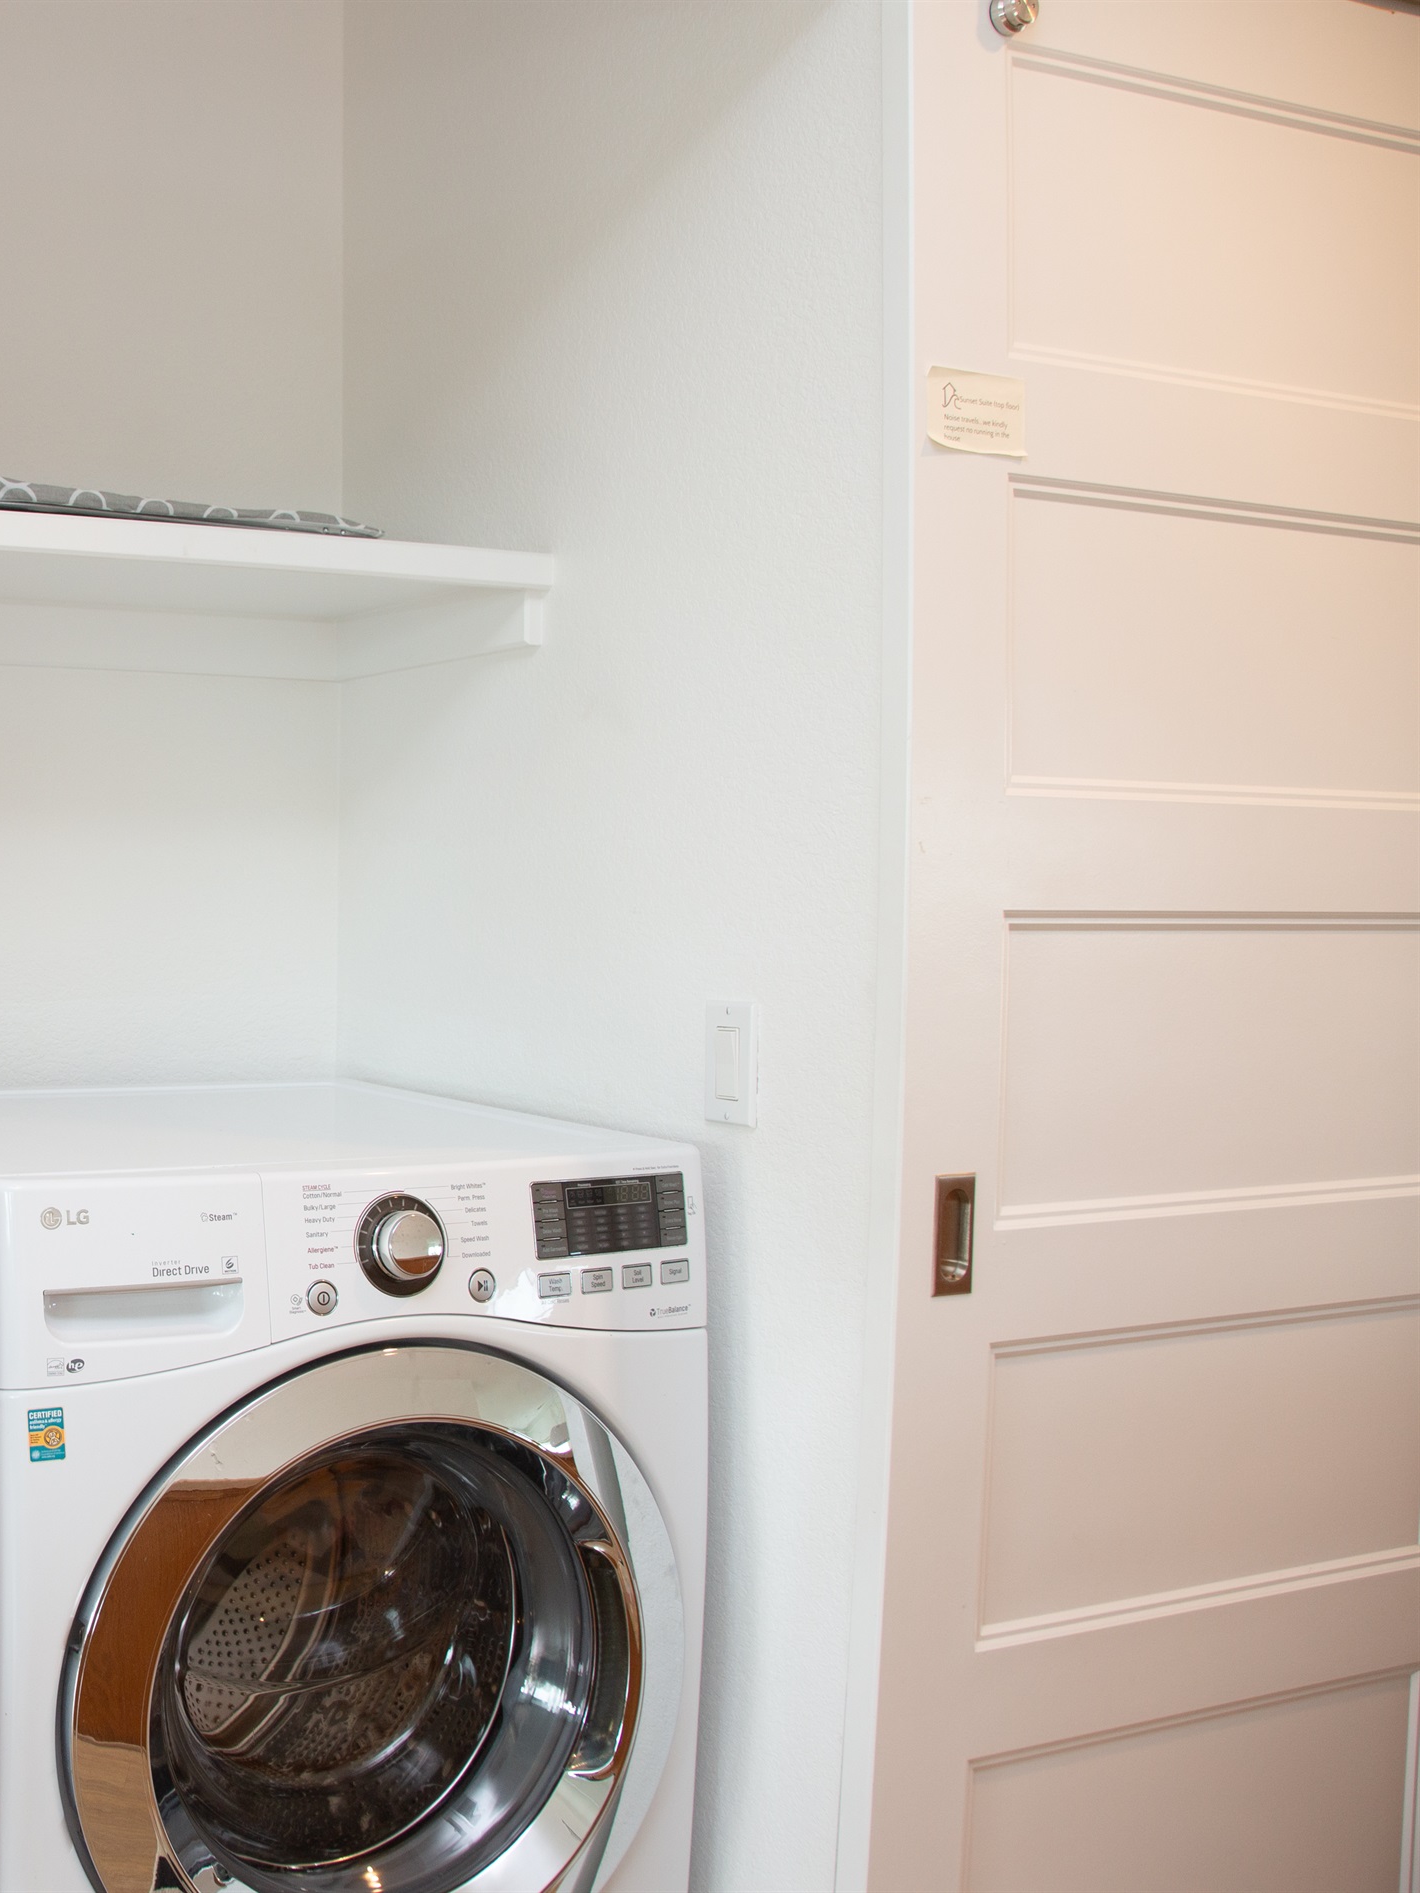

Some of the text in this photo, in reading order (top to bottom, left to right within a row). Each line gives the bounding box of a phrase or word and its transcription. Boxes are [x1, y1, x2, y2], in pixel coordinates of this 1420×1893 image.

[66, 1209, 90, 1226] LG
[152, 1264, 210, 1277] Direct Drive
[28, 1410, 62, 1419] CERTIFIED
